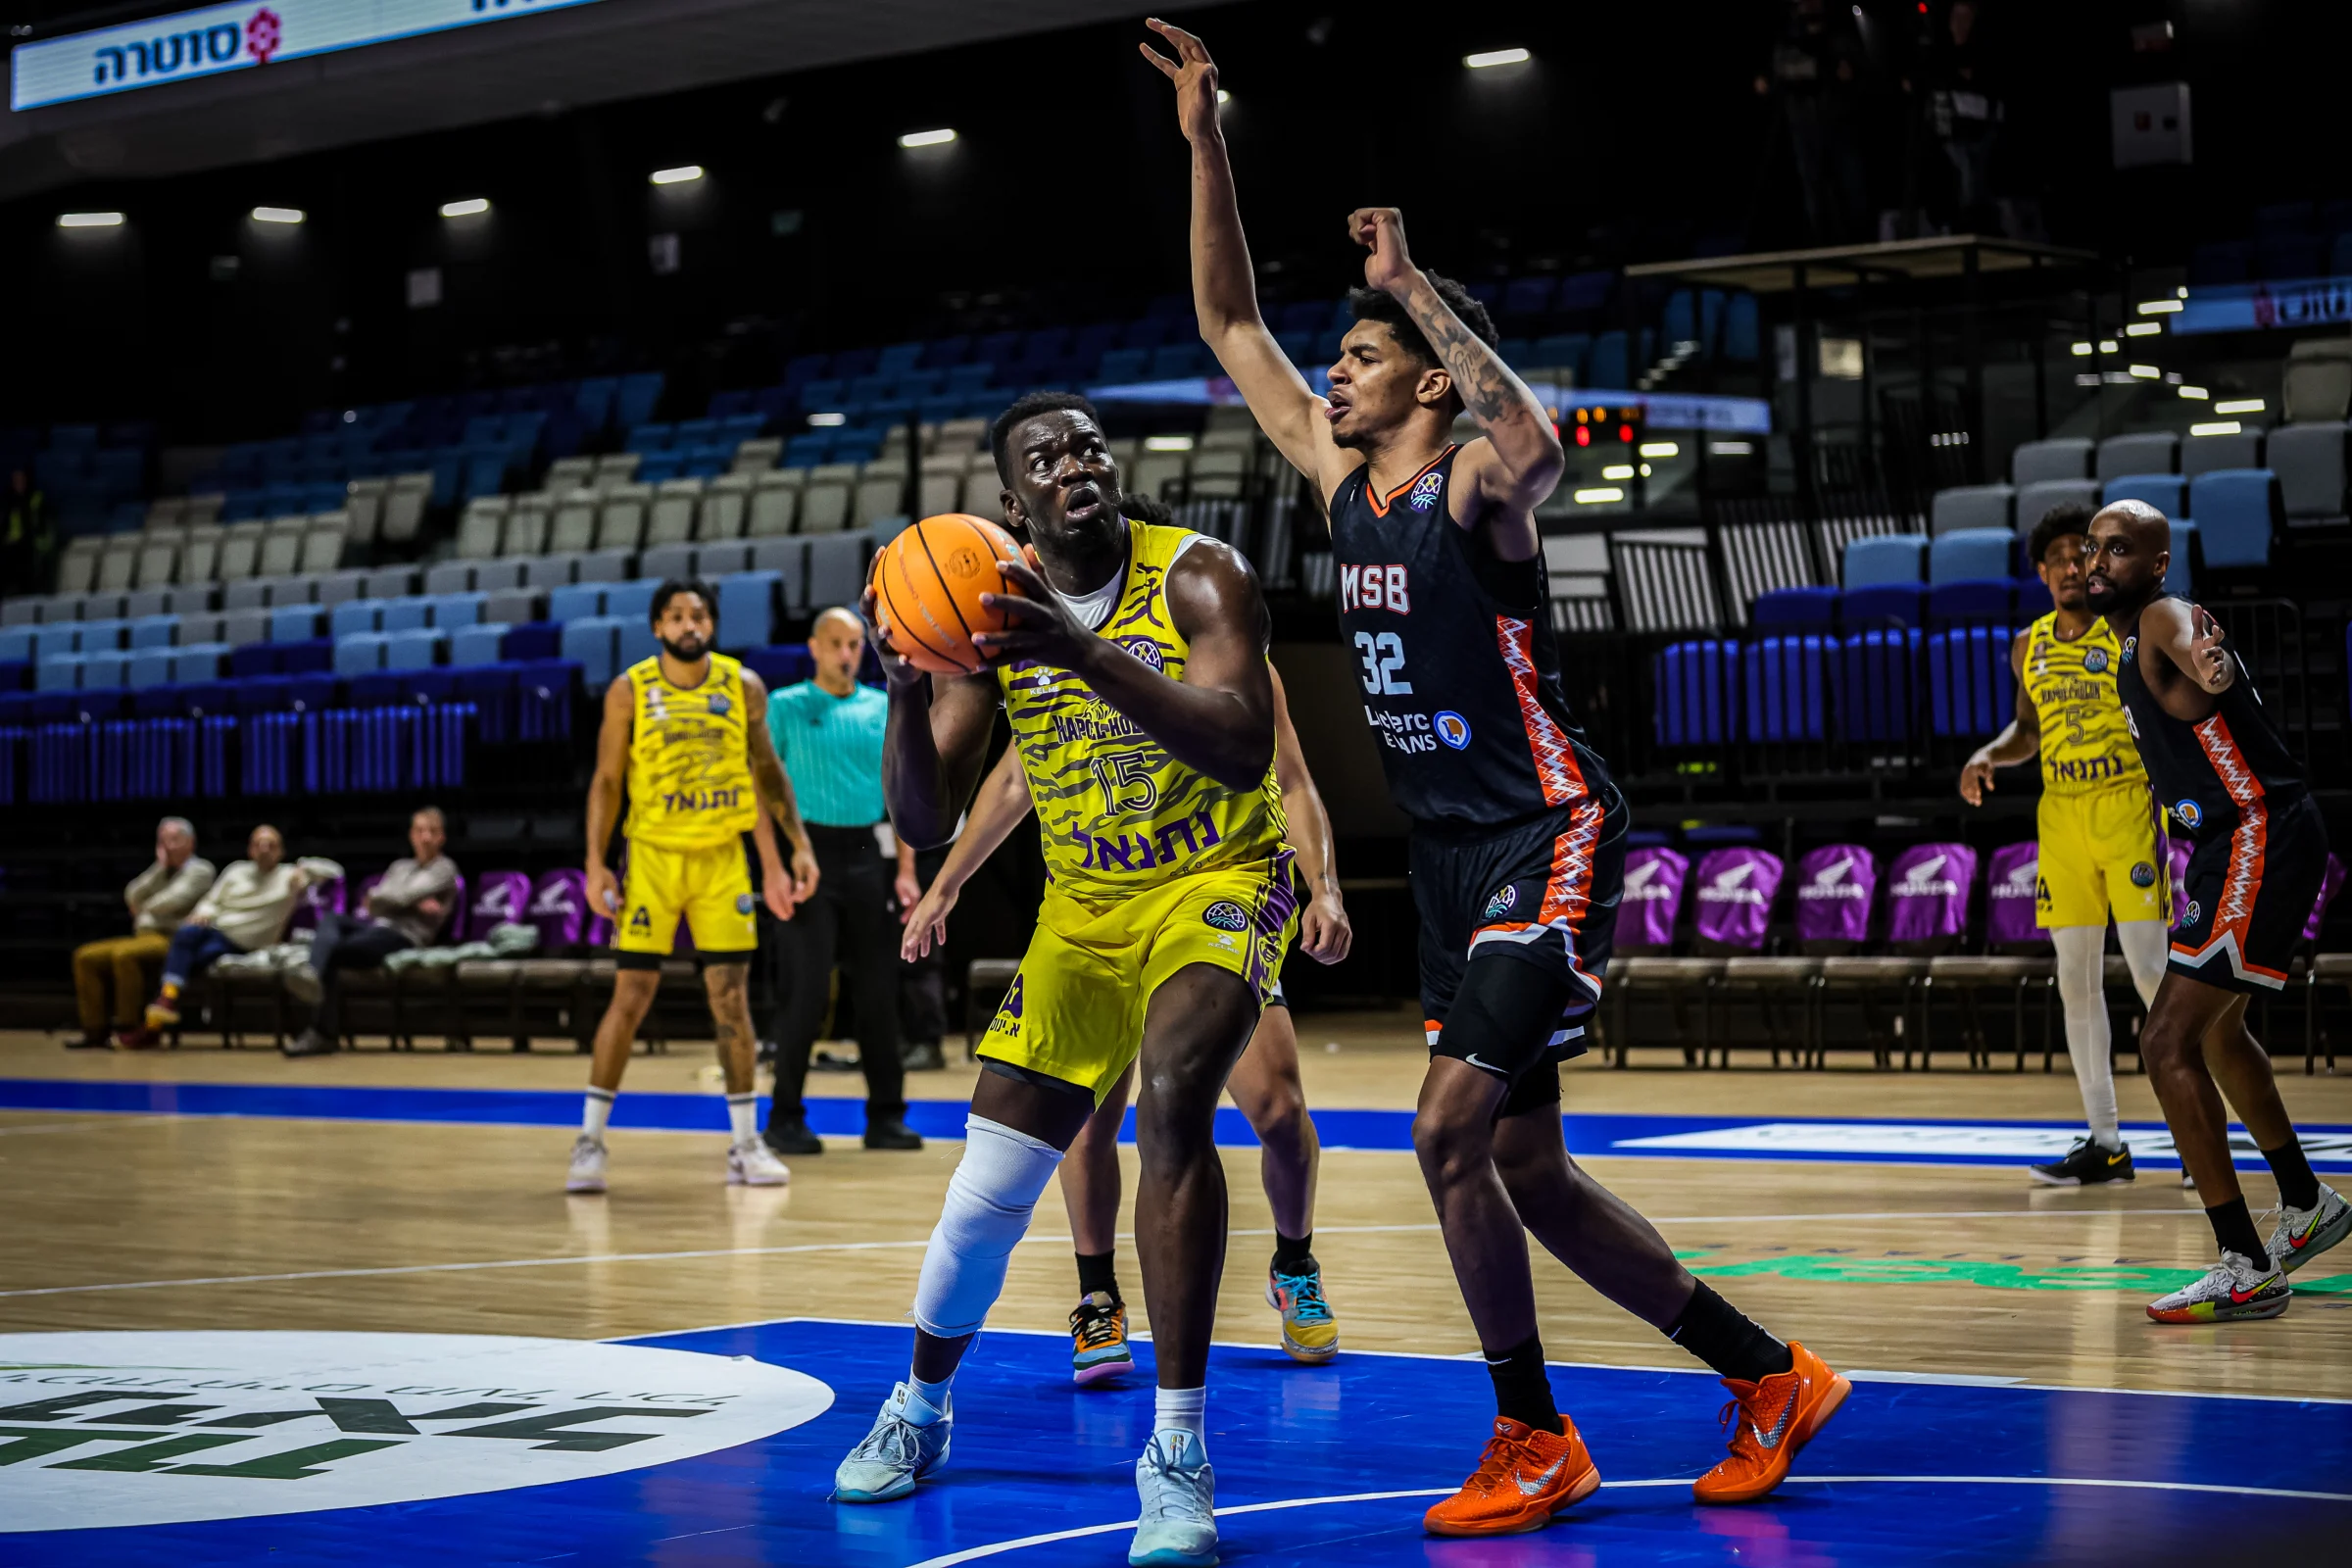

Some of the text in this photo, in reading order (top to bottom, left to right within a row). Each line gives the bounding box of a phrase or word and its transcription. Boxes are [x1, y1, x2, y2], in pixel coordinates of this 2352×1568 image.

[94, 23, 241, 85] סוטרה
[1340, 564, 1411, 615] MSB
[1029, 685, 1059, 695] KELME
[1354, 631, 1413, 695] 32
[2066, 706, 2085, 746] 5
[1090, 751, 1158, 817] 15
[1072, 811, 1222, 872] נתנאל
[1623, 884, 1672, 902] ONDA
